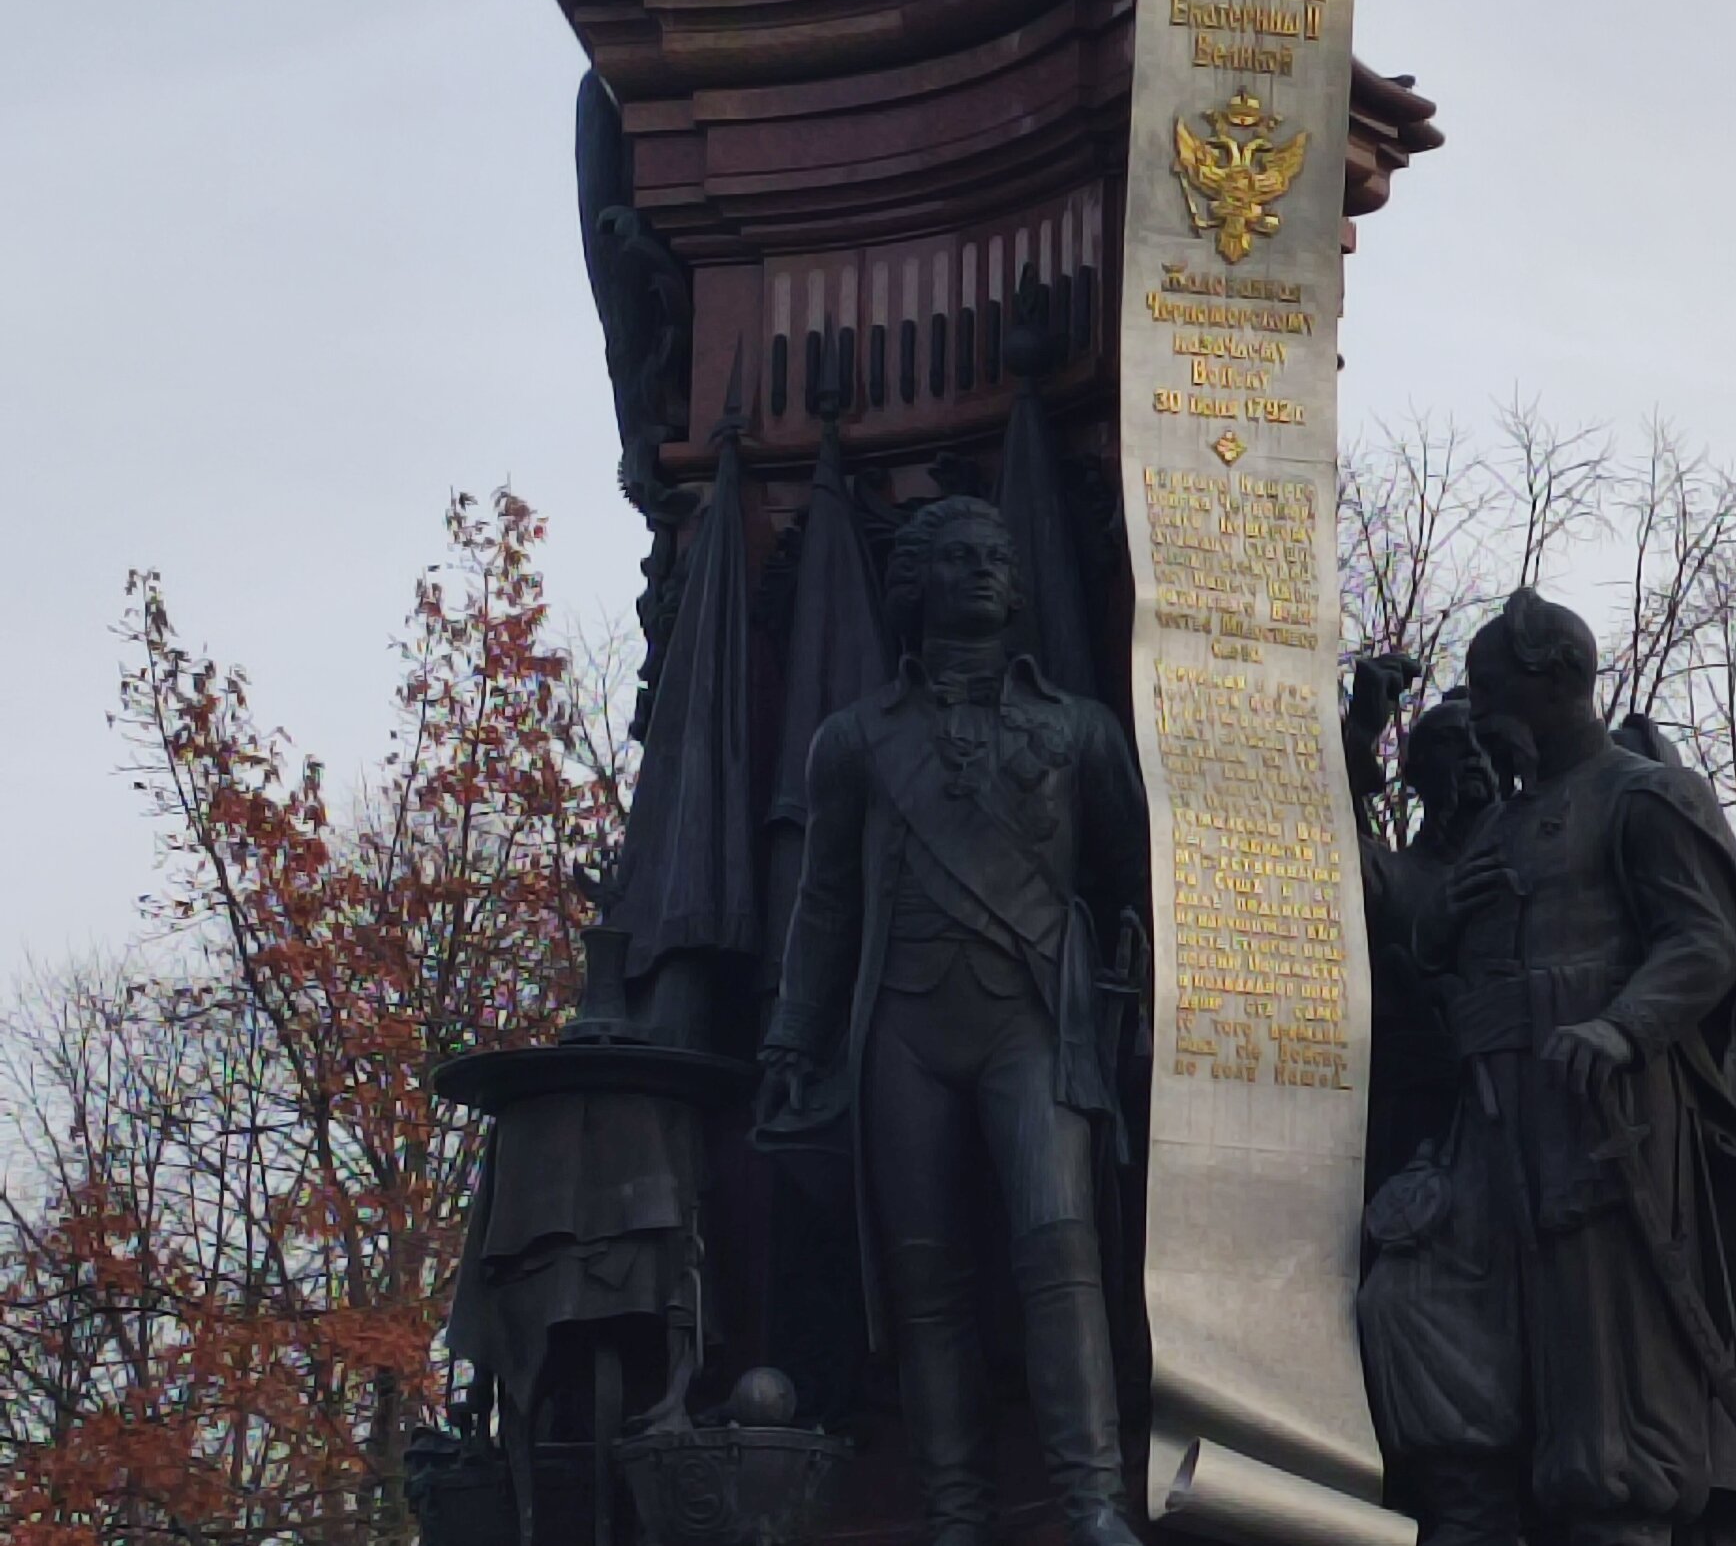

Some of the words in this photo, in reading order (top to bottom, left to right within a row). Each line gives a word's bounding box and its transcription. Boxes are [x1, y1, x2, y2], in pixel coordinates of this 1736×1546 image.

[1304, 3, 1323, 41] II
[1191, 31, 1294, 77] Великой
[1154, 387, 1182, 414] 30
